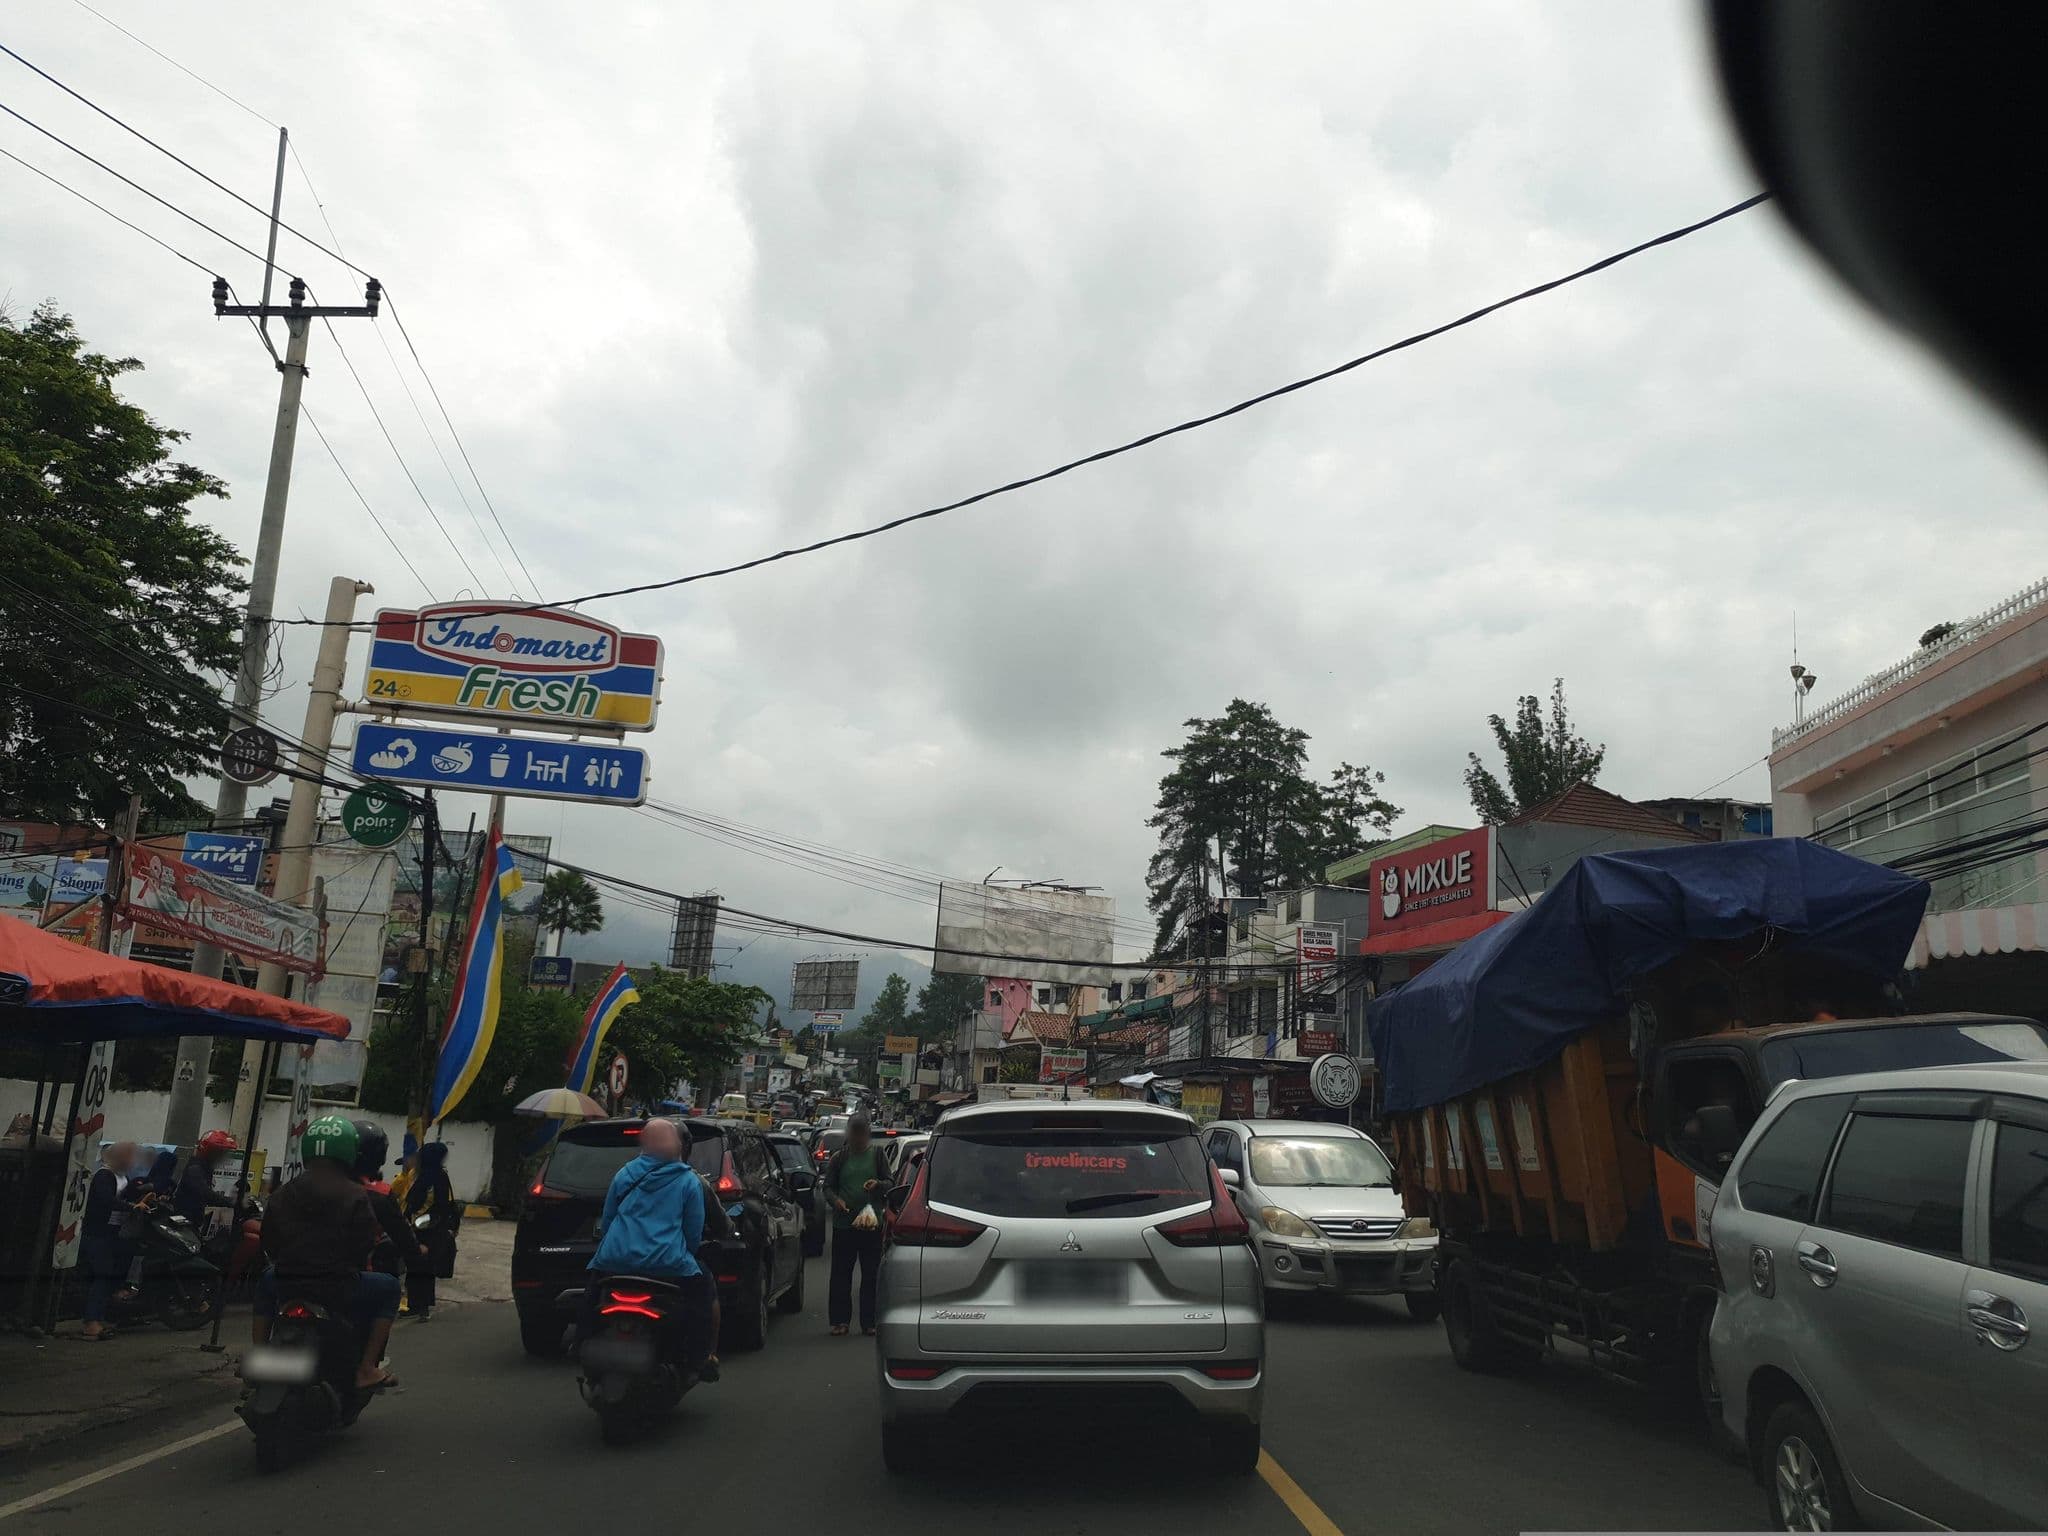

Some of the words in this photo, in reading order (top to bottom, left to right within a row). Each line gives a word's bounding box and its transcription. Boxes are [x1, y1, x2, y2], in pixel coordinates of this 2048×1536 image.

[427, 616, 607, 661] Indomaret
[372, 679, 397, 696] 24
[458, 666, 598, 716] Fresh
[1404, 850, 1471, 898] MIXUE
[307, 1123, 343, 1137] Grab
[931, 1310, 987, 1320] XPANDER
